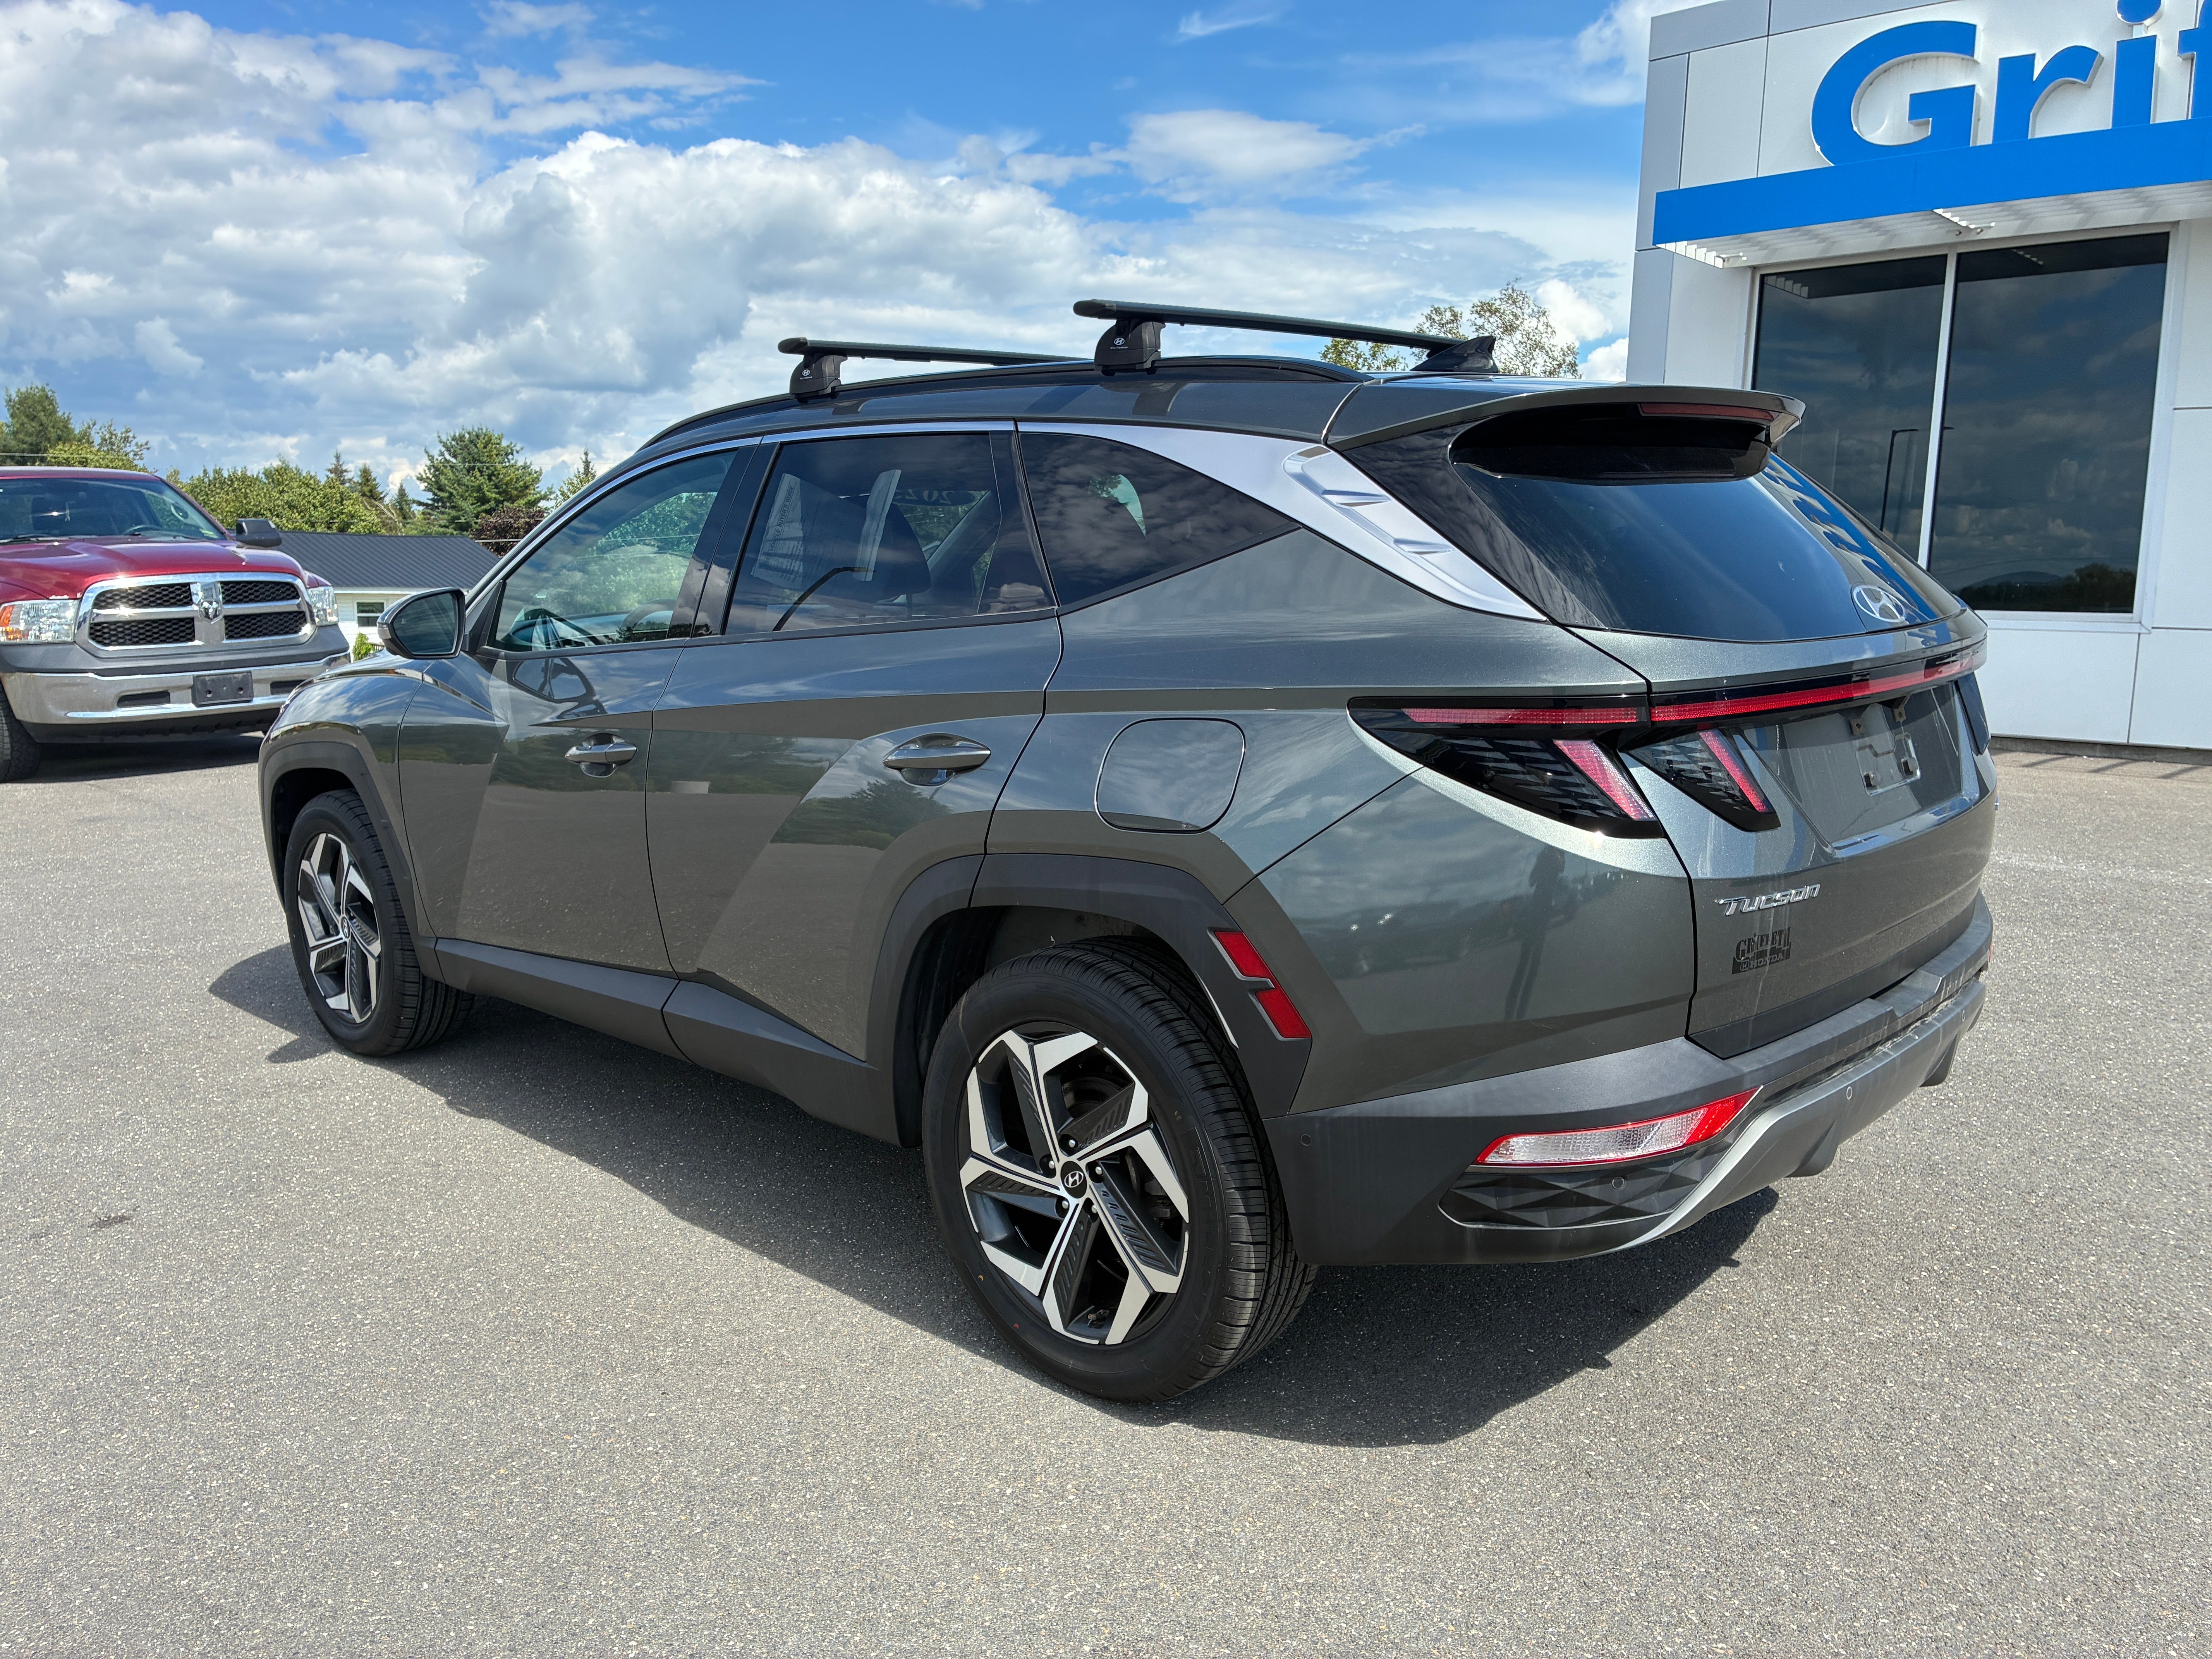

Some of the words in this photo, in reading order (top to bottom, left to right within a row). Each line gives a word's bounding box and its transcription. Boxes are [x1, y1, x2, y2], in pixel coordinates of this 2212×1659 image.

[785, 484, 794, 503] GUIDE
[1718, 883, 1820, 915] TUCSON
[1750, 953, 1784, 969] HONDA
